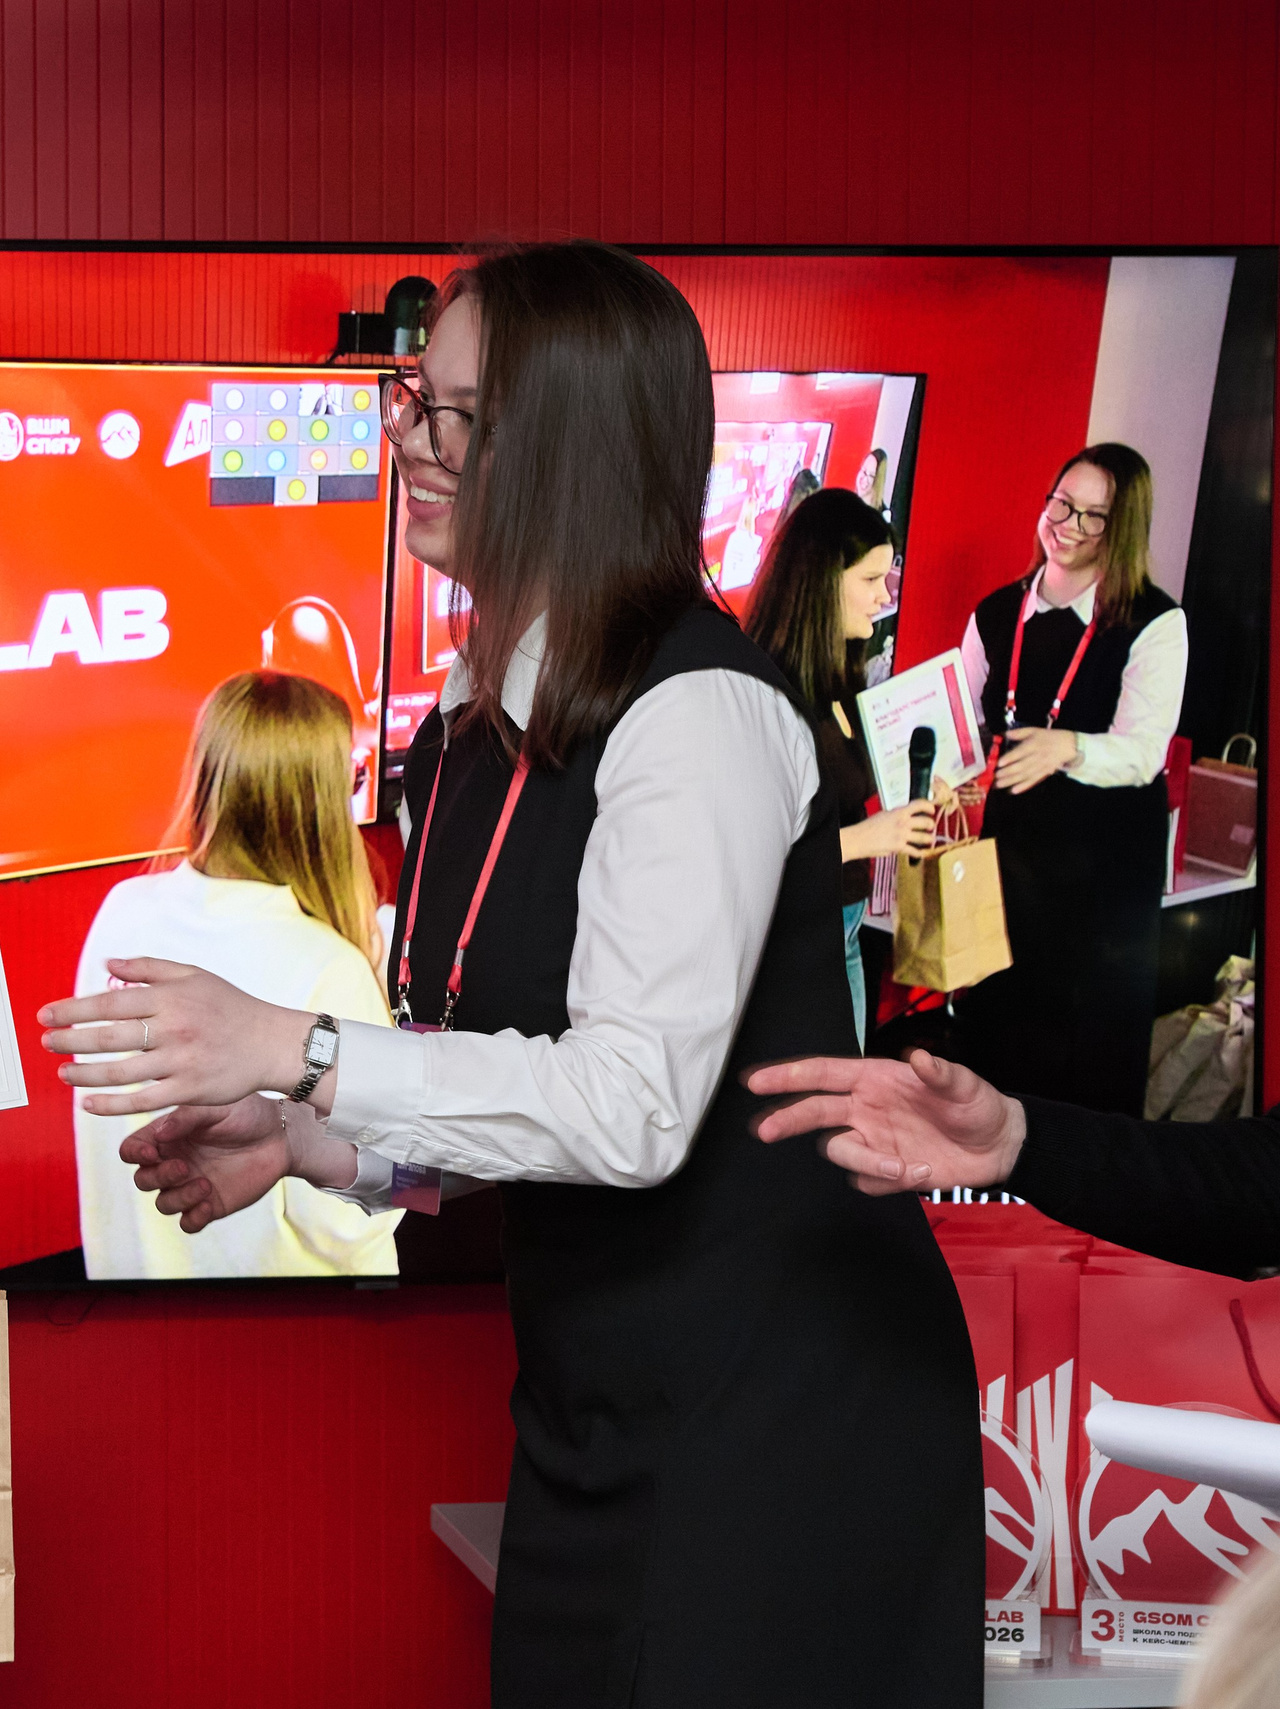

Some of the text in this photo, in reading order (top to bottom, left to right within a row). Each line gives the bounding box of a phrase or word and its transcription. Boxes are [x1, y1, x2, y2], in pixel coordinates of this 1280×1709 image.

[984, 1609, 1024, 1623] LAB
[1133, 1611, 1193, 1626] GSOM
[1091, 1609, 1116, 1642] 3
